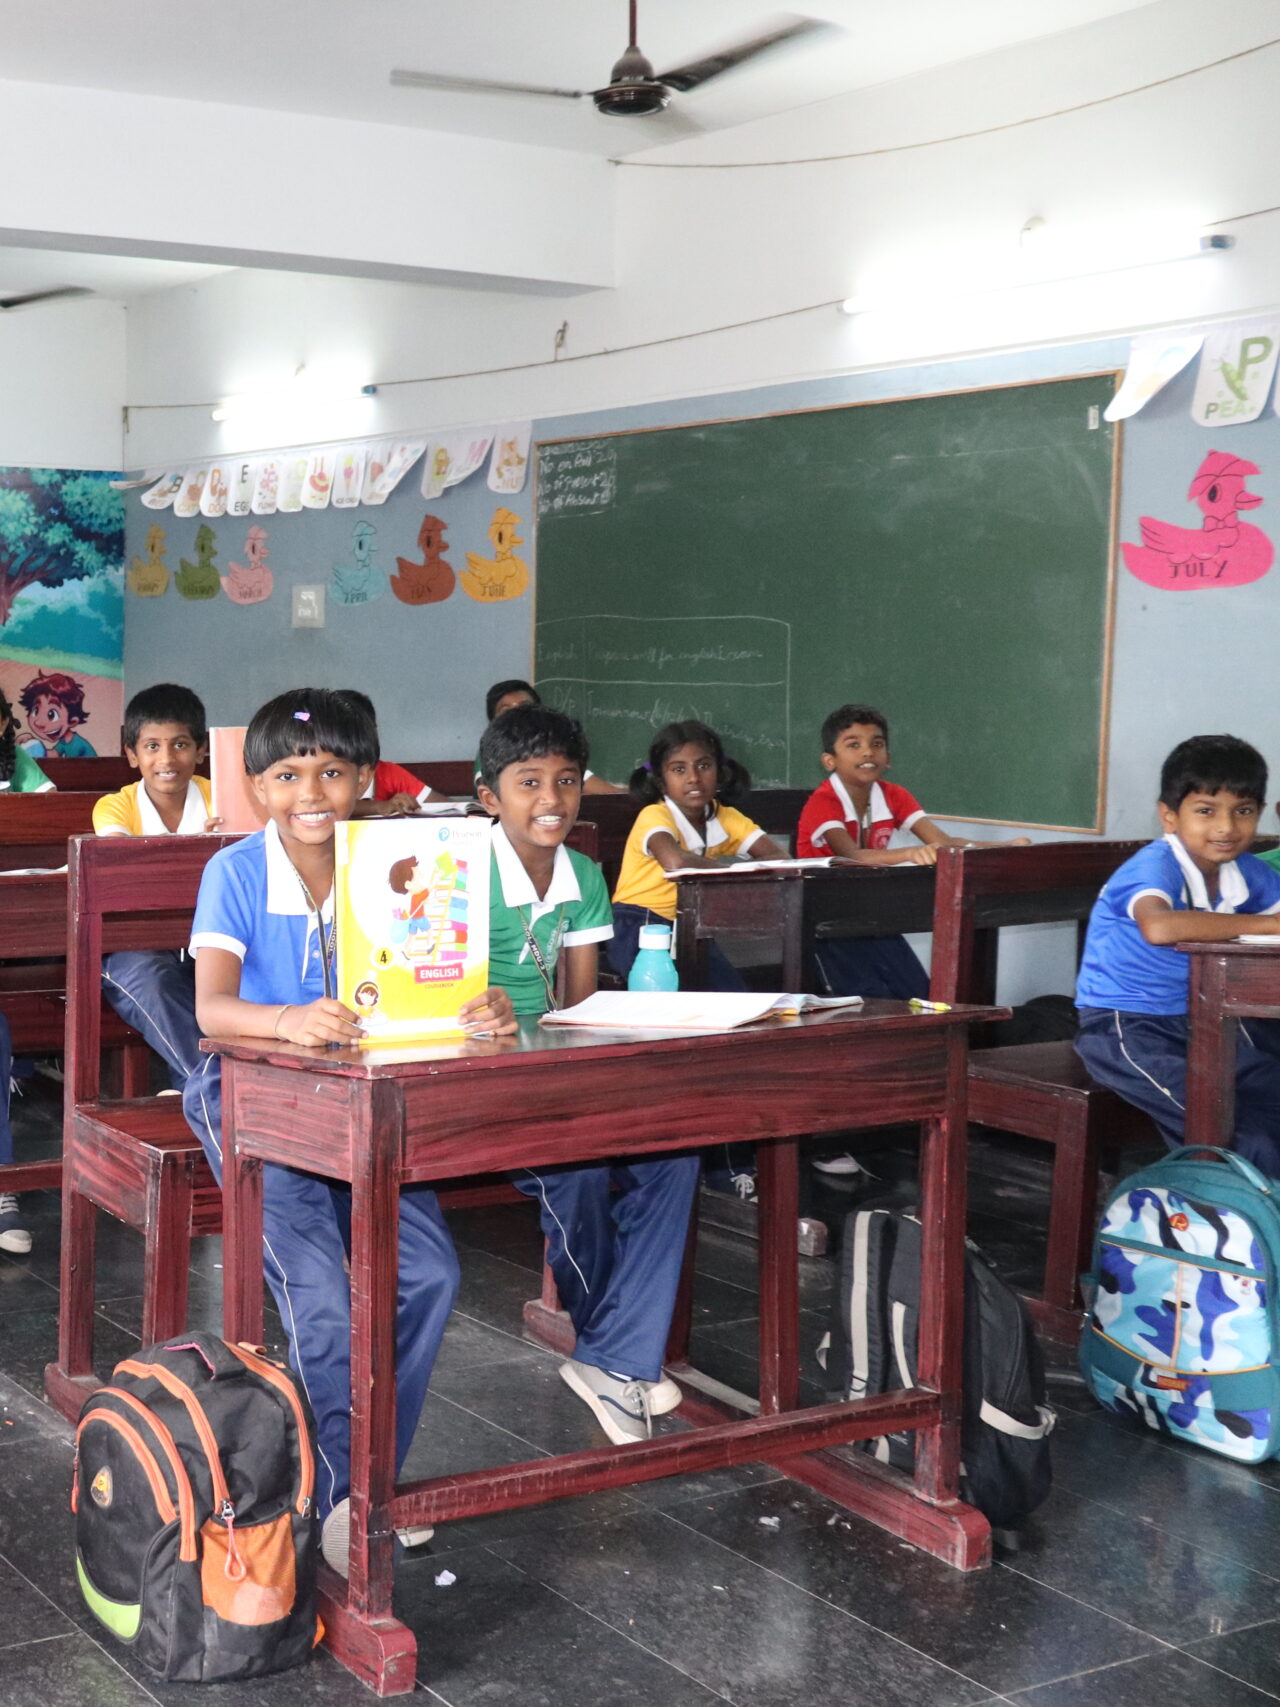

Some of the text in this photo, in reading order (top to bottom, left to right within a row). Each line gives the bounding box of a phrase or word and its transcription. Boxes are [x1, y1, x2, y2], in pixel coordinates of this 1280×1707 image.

[1237, 336, 1273, 381] P
[1169, 560, 1230, 579] JULY
[420, 968, 459, 979] ENGLISH
